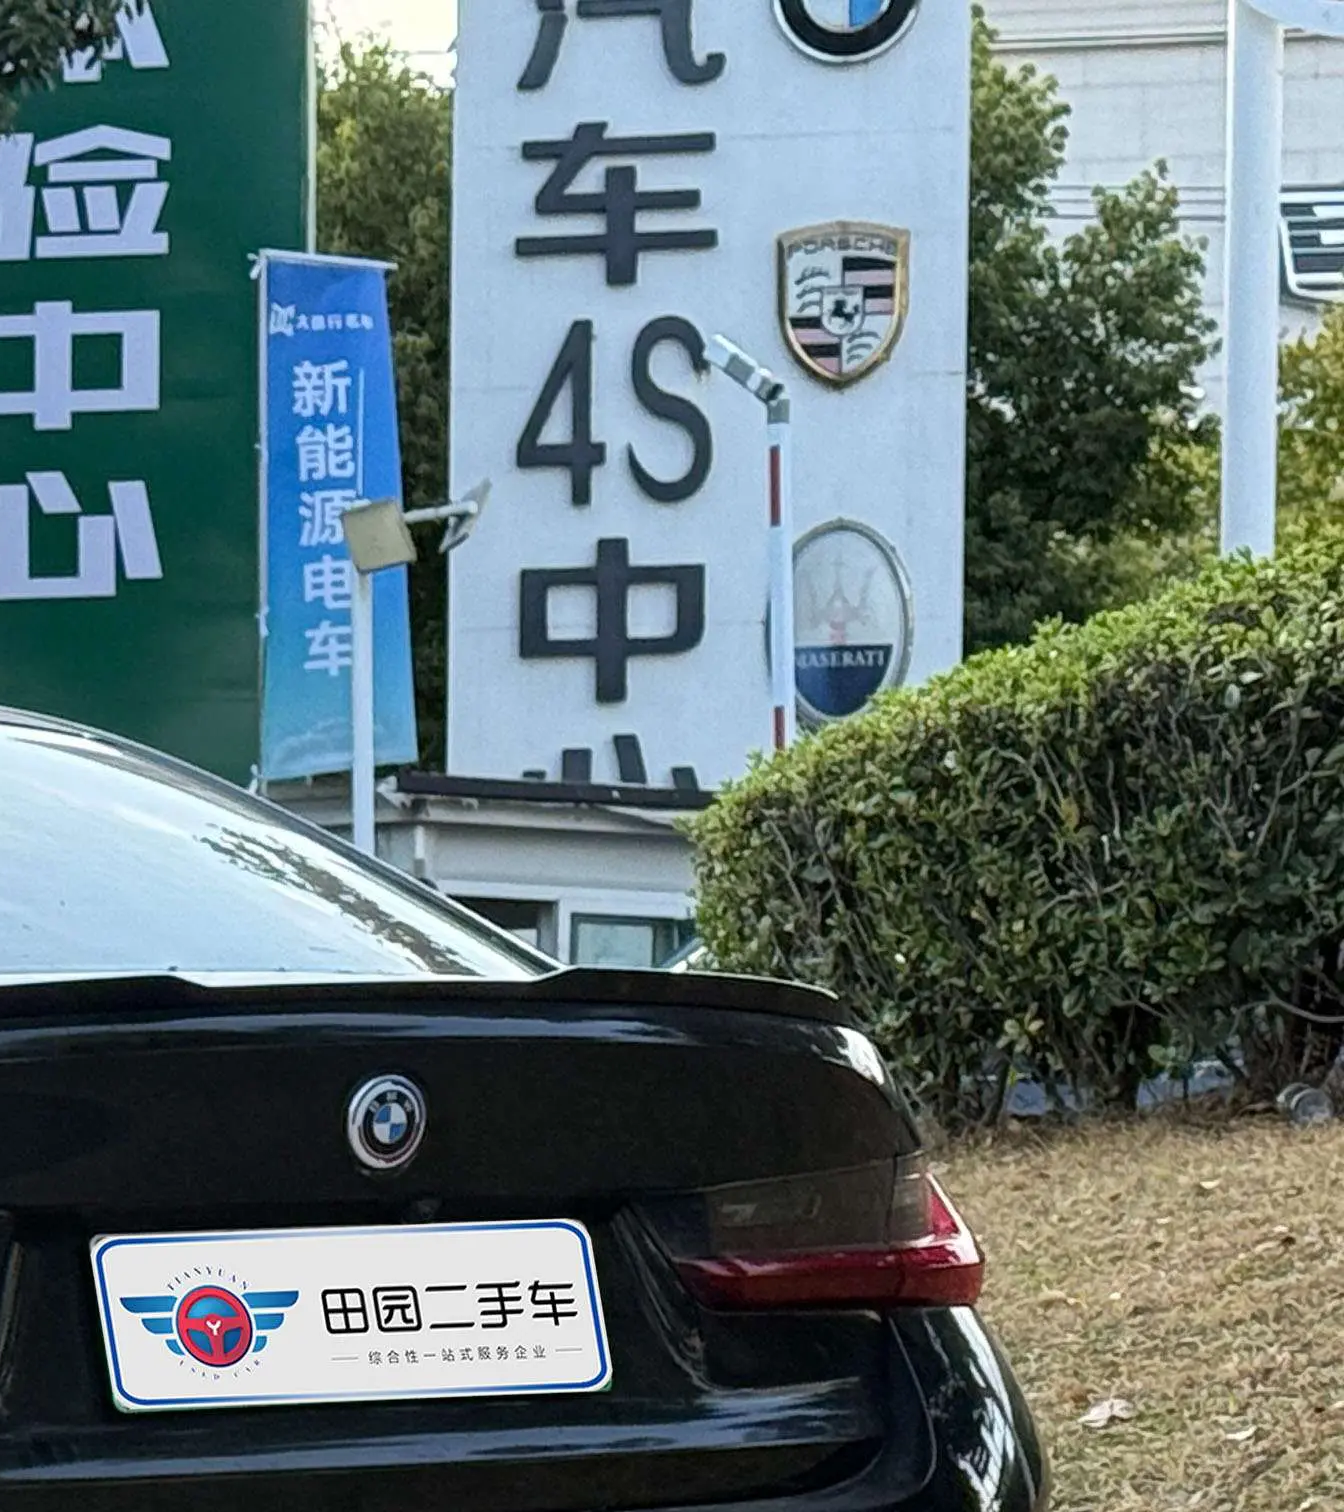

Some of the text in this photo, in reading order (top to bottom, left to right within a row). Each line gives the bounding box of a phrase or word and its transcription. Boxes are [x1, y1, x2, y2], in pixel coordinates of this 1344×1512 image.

[292, 359, 359, 677] 新能源电车
